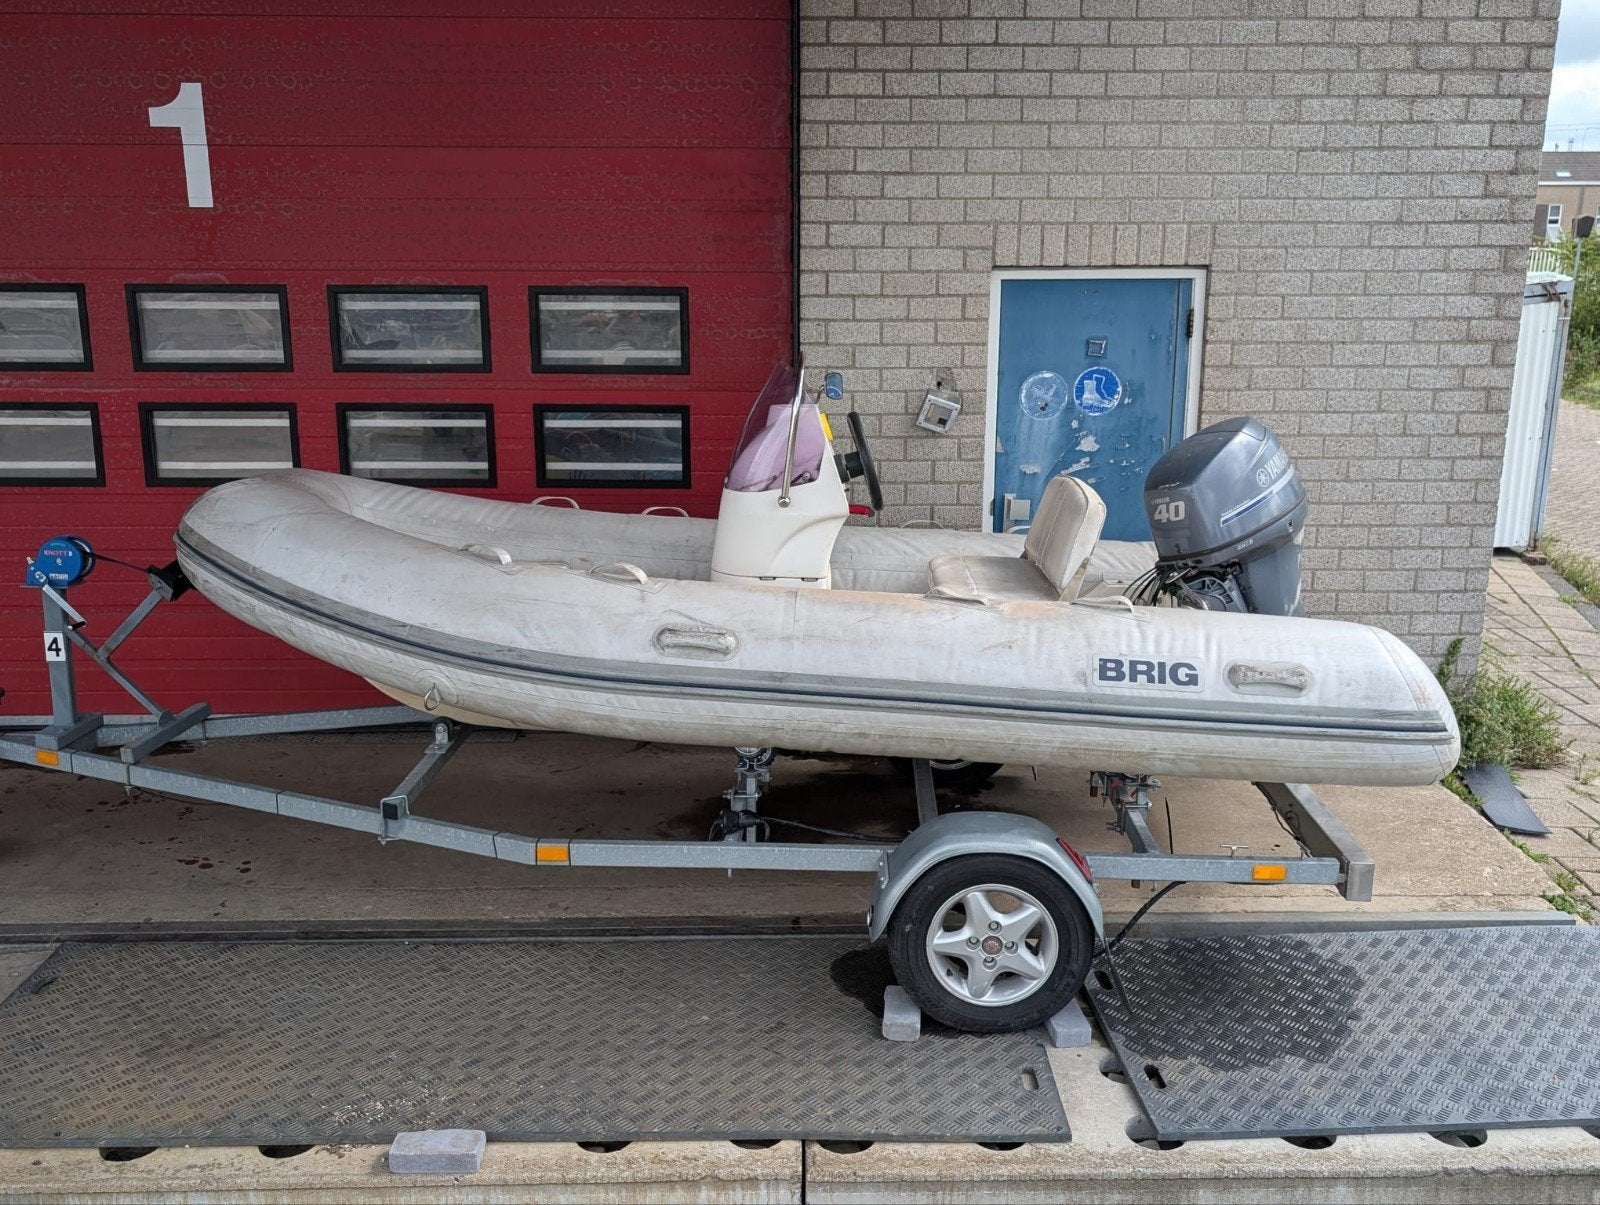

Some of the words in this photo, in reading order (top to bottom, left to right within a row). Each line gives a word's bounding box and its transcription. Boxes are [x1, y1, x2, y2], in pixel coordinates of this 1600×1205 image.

[148, 82, 214, 208] 1
[1154, 500, 1186, 523] 40
[47, 636, 62, 657] 4
[1098, 657, 1199, 687] BRIG
